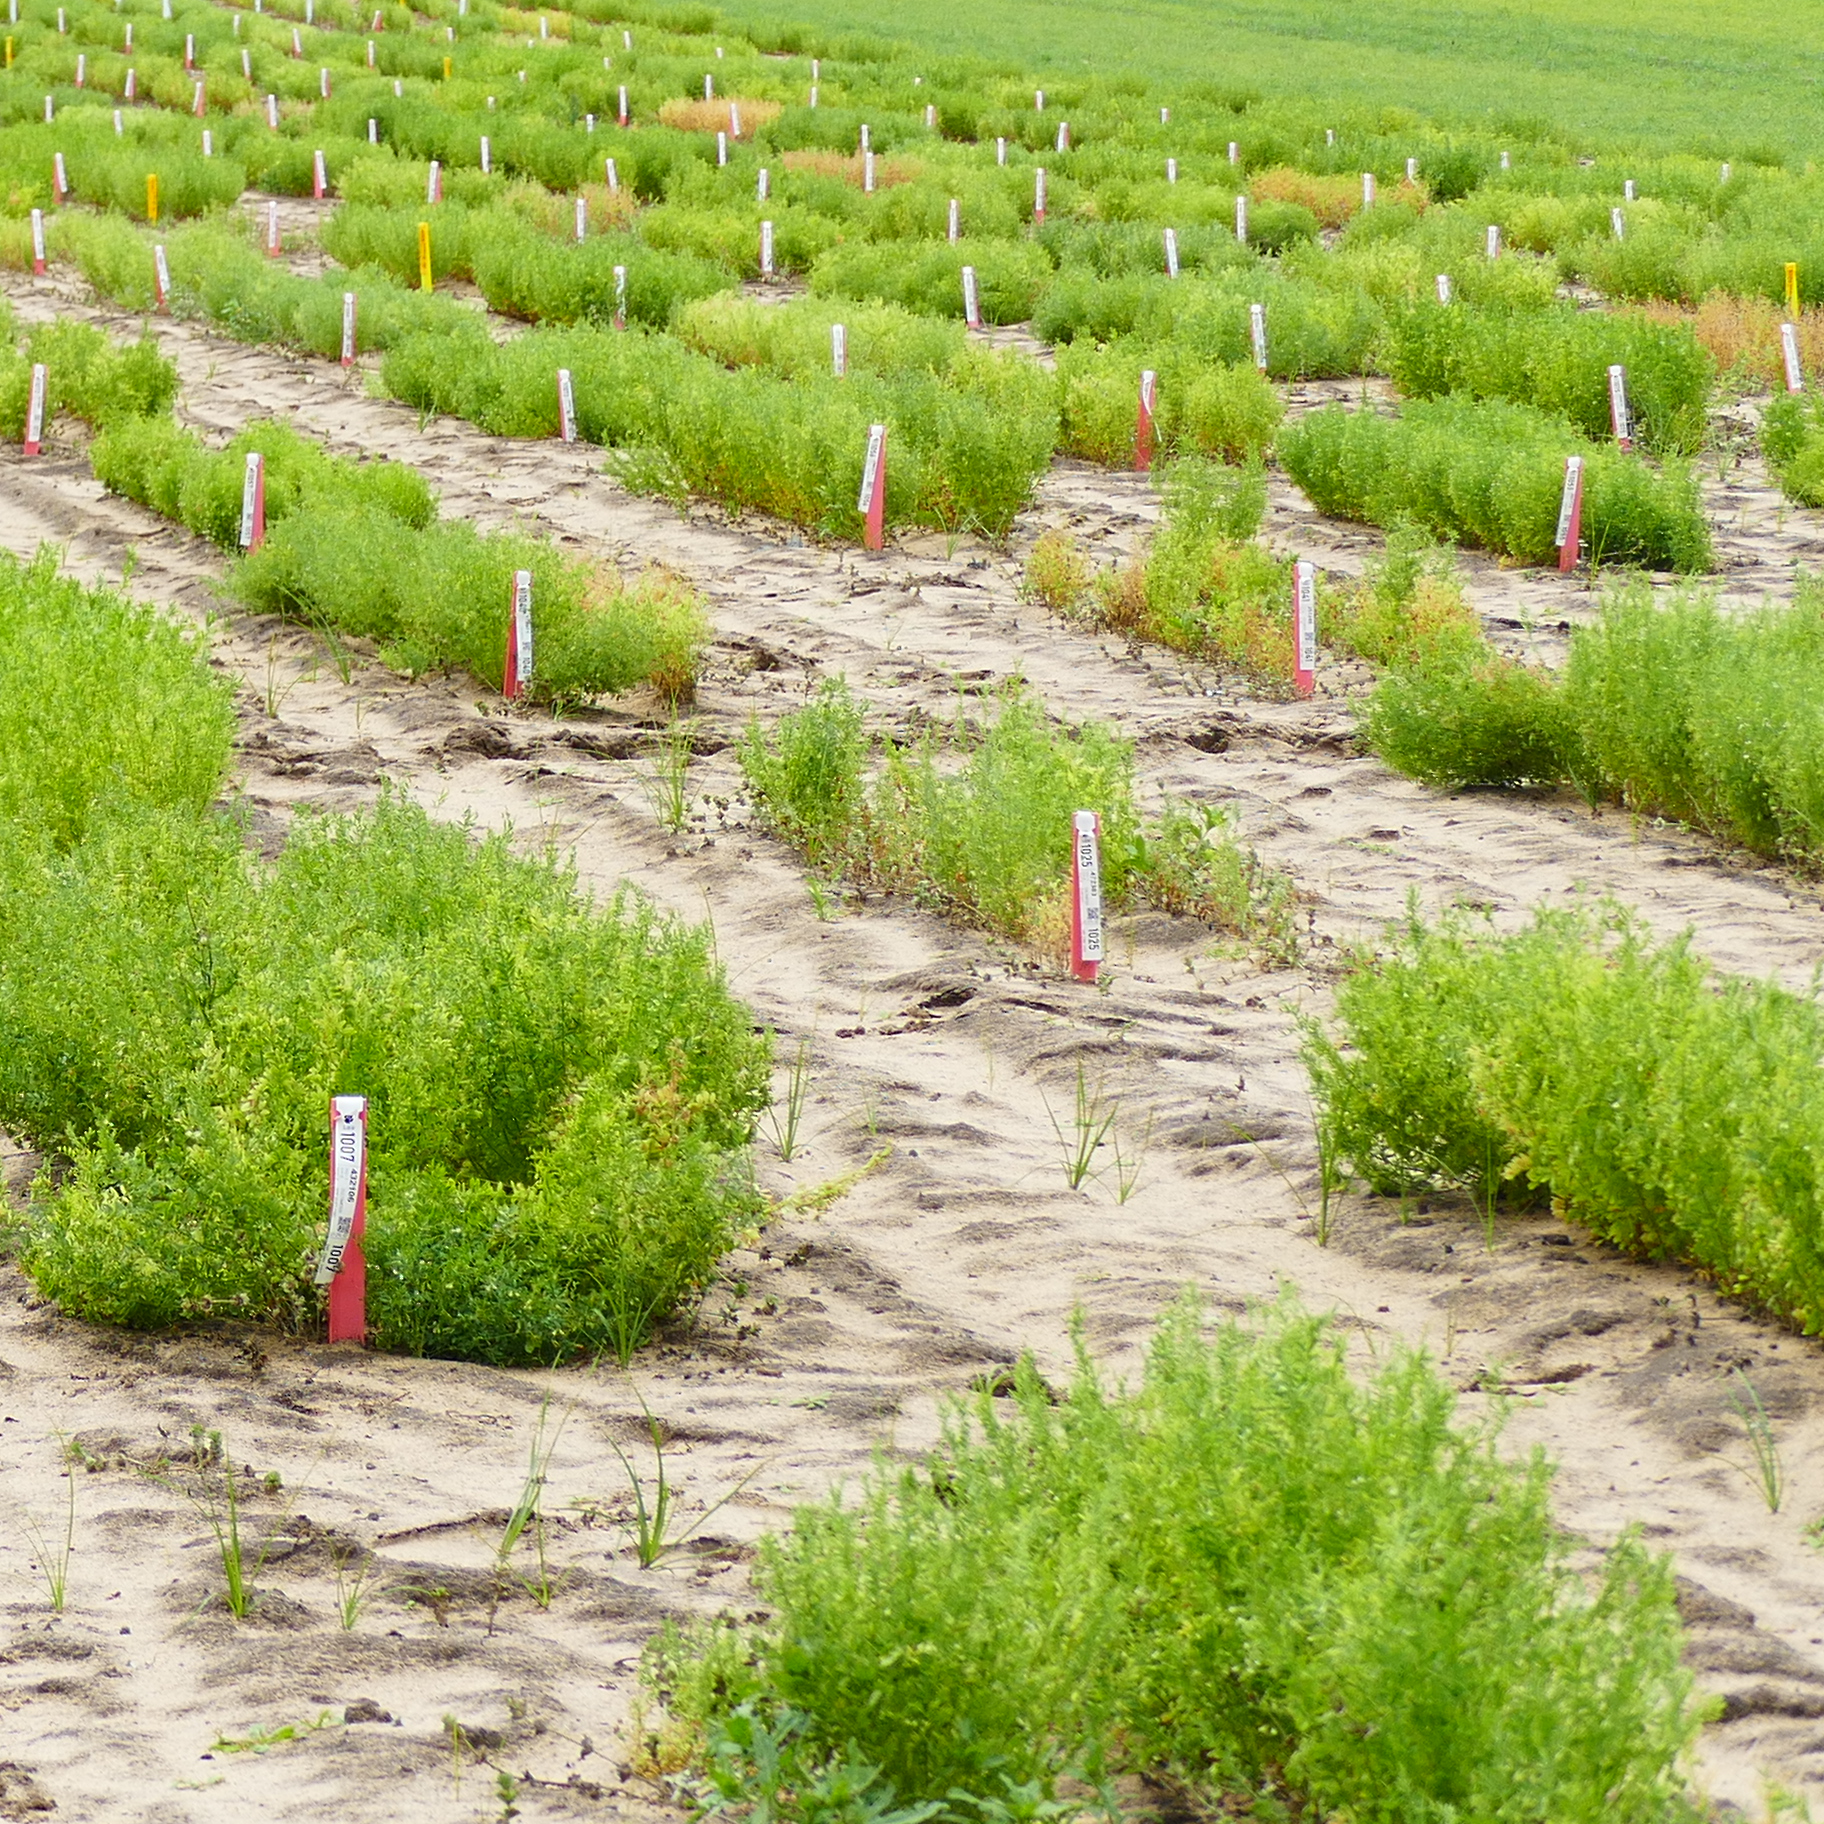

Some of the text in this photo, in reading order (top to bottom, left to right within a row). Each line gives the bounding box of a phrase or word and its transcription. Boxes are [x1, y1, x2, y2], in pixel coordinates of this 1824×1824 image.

[1081, 844, 1093, 867] 1025
[1088, 928, 1100, 950] 1025
[340, 1132, 355, 1163] 1007
[347, 1169, 358, 1203] 432106
[325, 1245, 344, 1274] 1007
